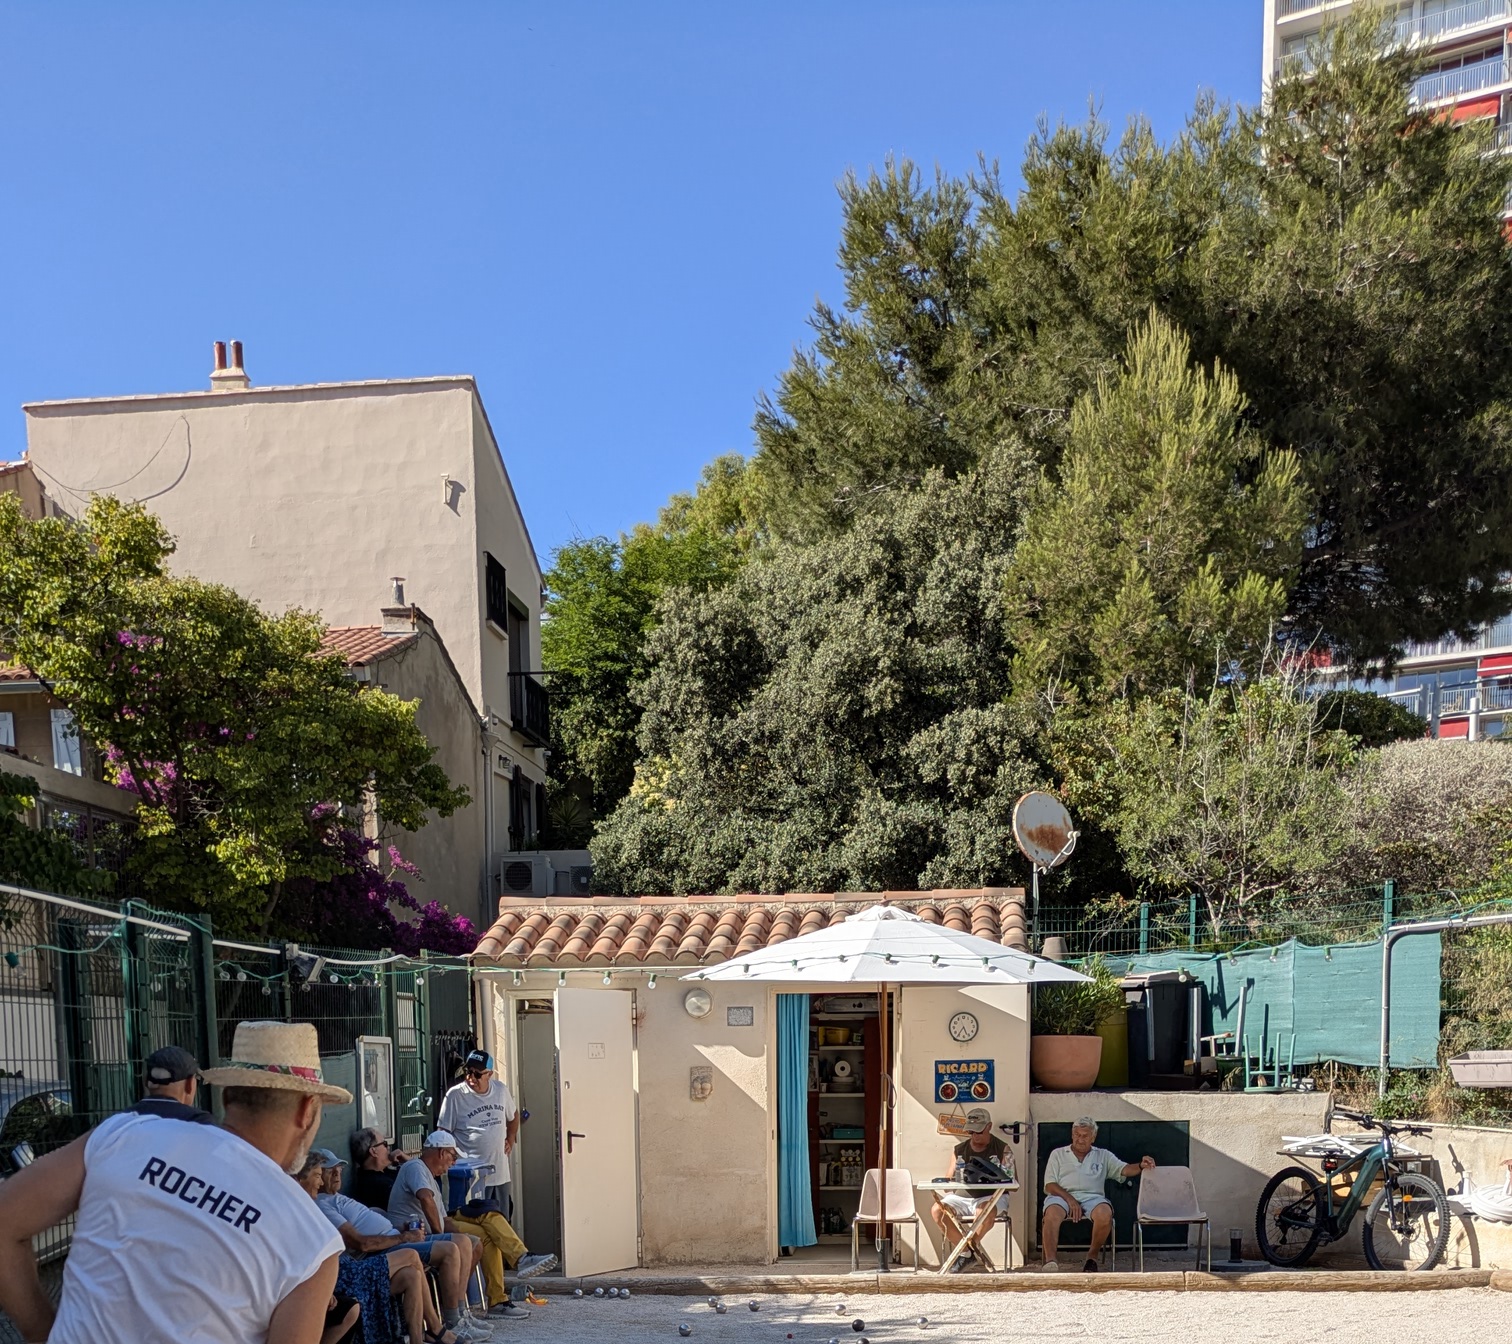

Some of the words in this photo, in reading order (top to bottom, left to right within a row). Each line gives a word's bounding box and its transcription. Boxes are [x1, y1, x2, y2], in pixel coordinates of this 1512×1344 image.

[938, 1062, 988, 1074] RICARD
[467, 1104, 493, 1119] MARINA
[138, 1156, 262, 1234] ROCHER
